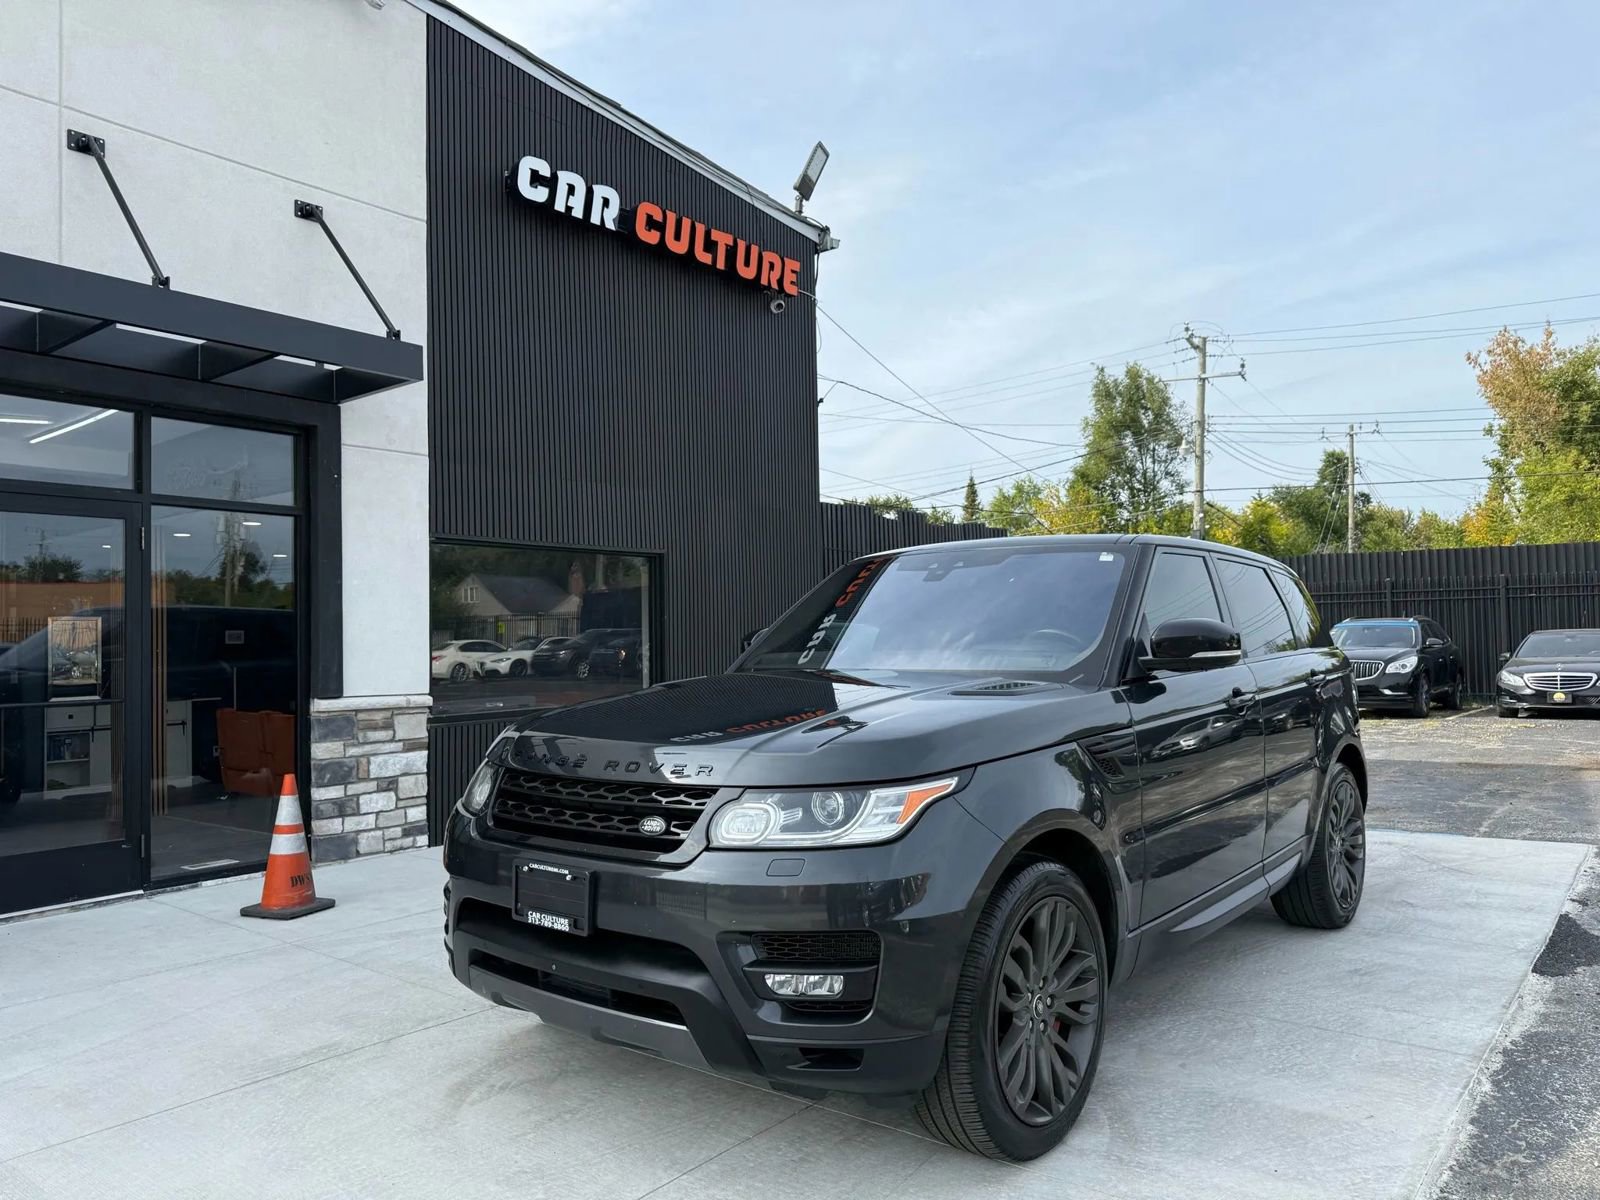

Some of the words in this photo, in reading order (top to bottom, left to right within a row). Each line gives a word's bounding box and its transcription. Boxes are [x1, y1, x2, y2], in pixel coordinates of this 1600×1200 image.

[517, 155, 620, 231] CAR
[635, 201, 800, 297] CULTURE
[603, 759, 714, 776] ROVER
[528, 911, 541, 920] CAR
[541, 914, 568, 925] CULTURE
